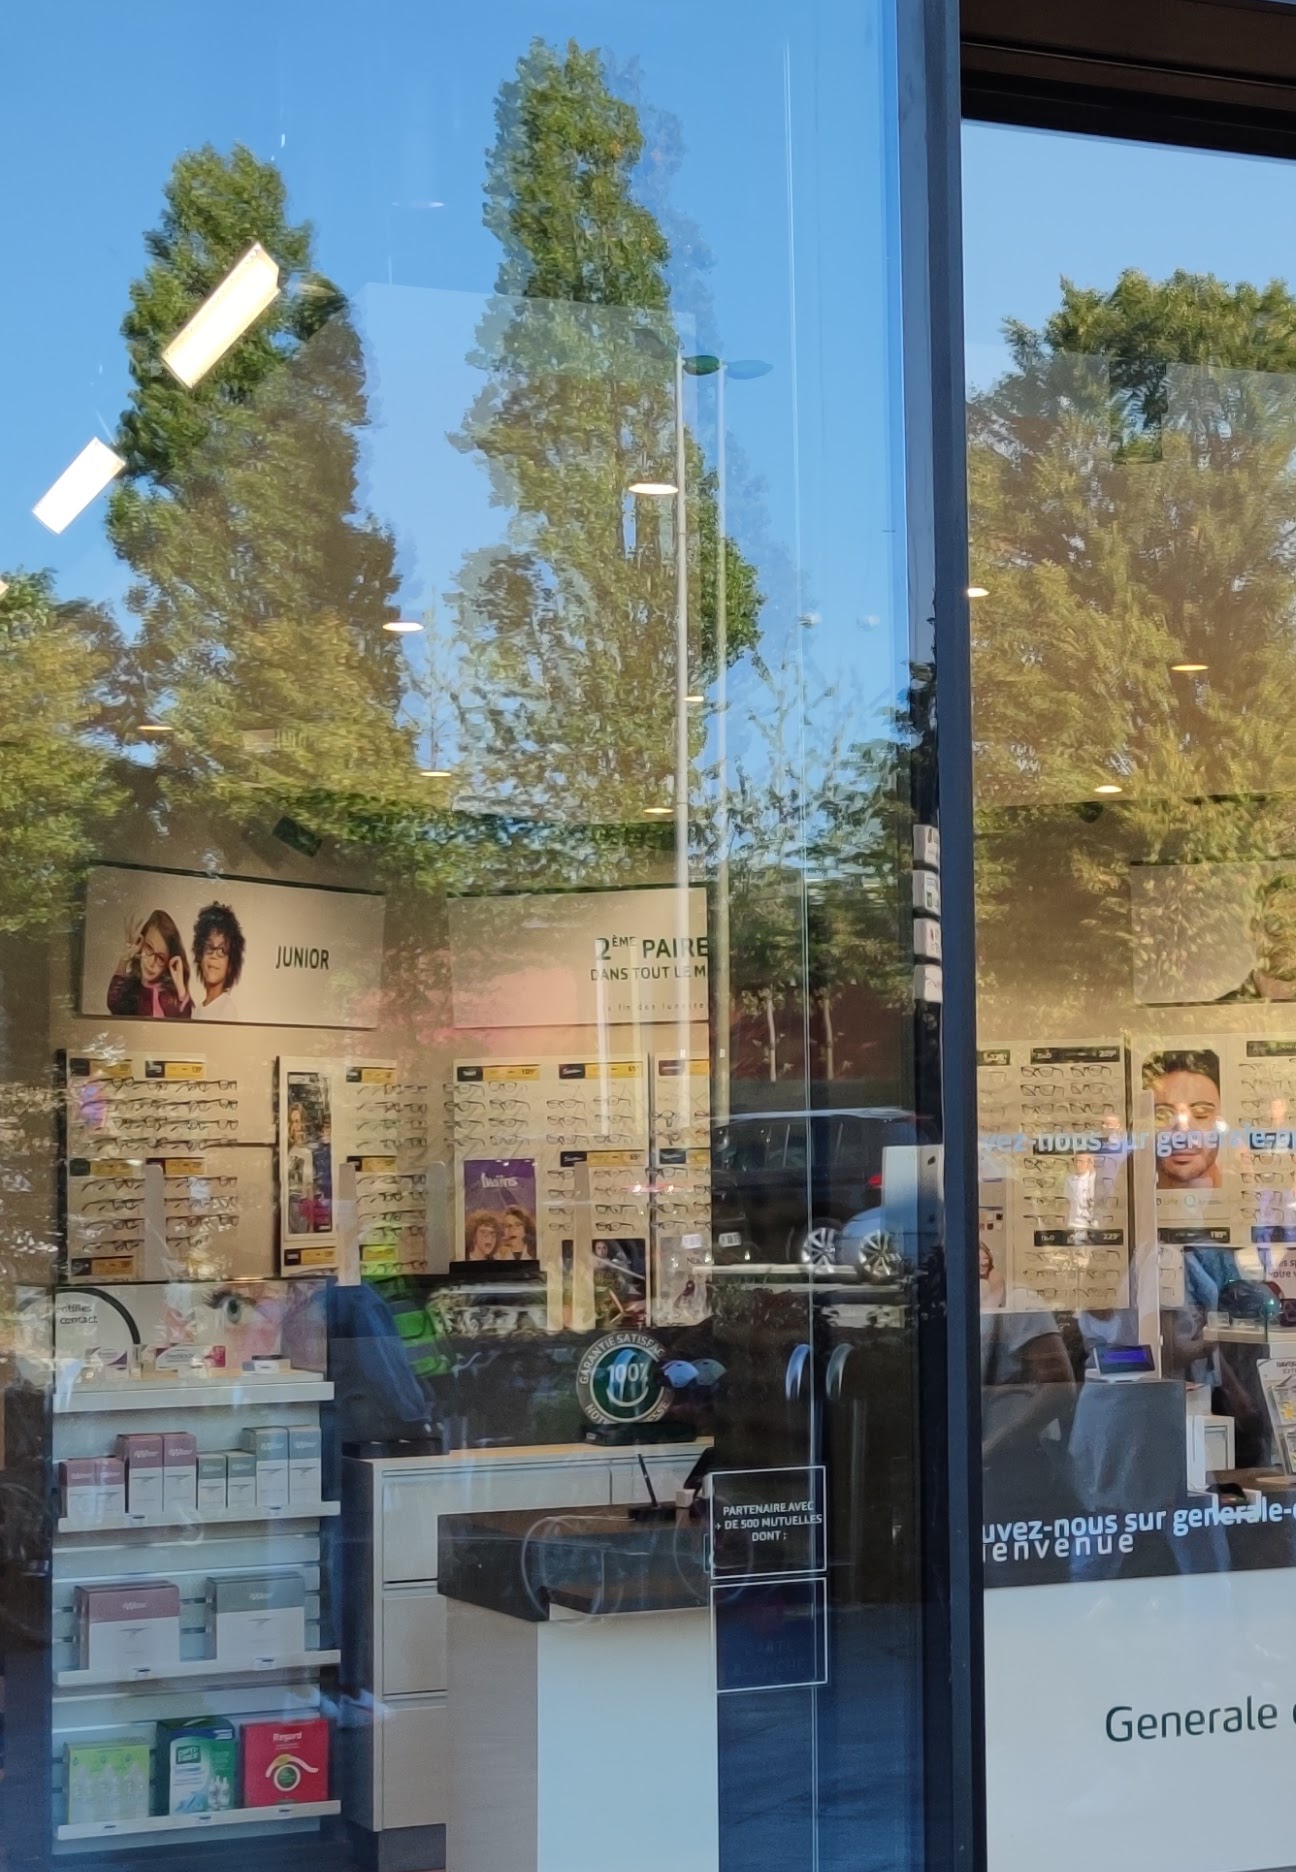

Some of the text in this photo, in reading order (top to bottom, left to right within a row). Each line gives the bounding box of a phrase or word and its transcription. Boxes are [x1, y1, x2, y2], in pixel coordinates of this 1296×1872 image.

[275, 945, 330, 971] JUNIOR
[590, 967, 629, 981] DANS
[631, 965, 670, 980] TOUT
[579, 1335, 616, 1385] GARANTIE
[607, 1362, 650, 1386] 100%
[722, 1500, 815, 1517] PARTENAIRE AVEC
[724, 1519, 740, 1530] DE
[740, 1518, 760, 1529] 500
[761, 1514, 823, 1528] MUTUELLES
[1124, 1510, 1167, 1533] sur
[751, 1531, 781, 1542] DONT
[1105, 1695, 1279, 1742] Generale
[272, 1730, 303, 1744] Regard
